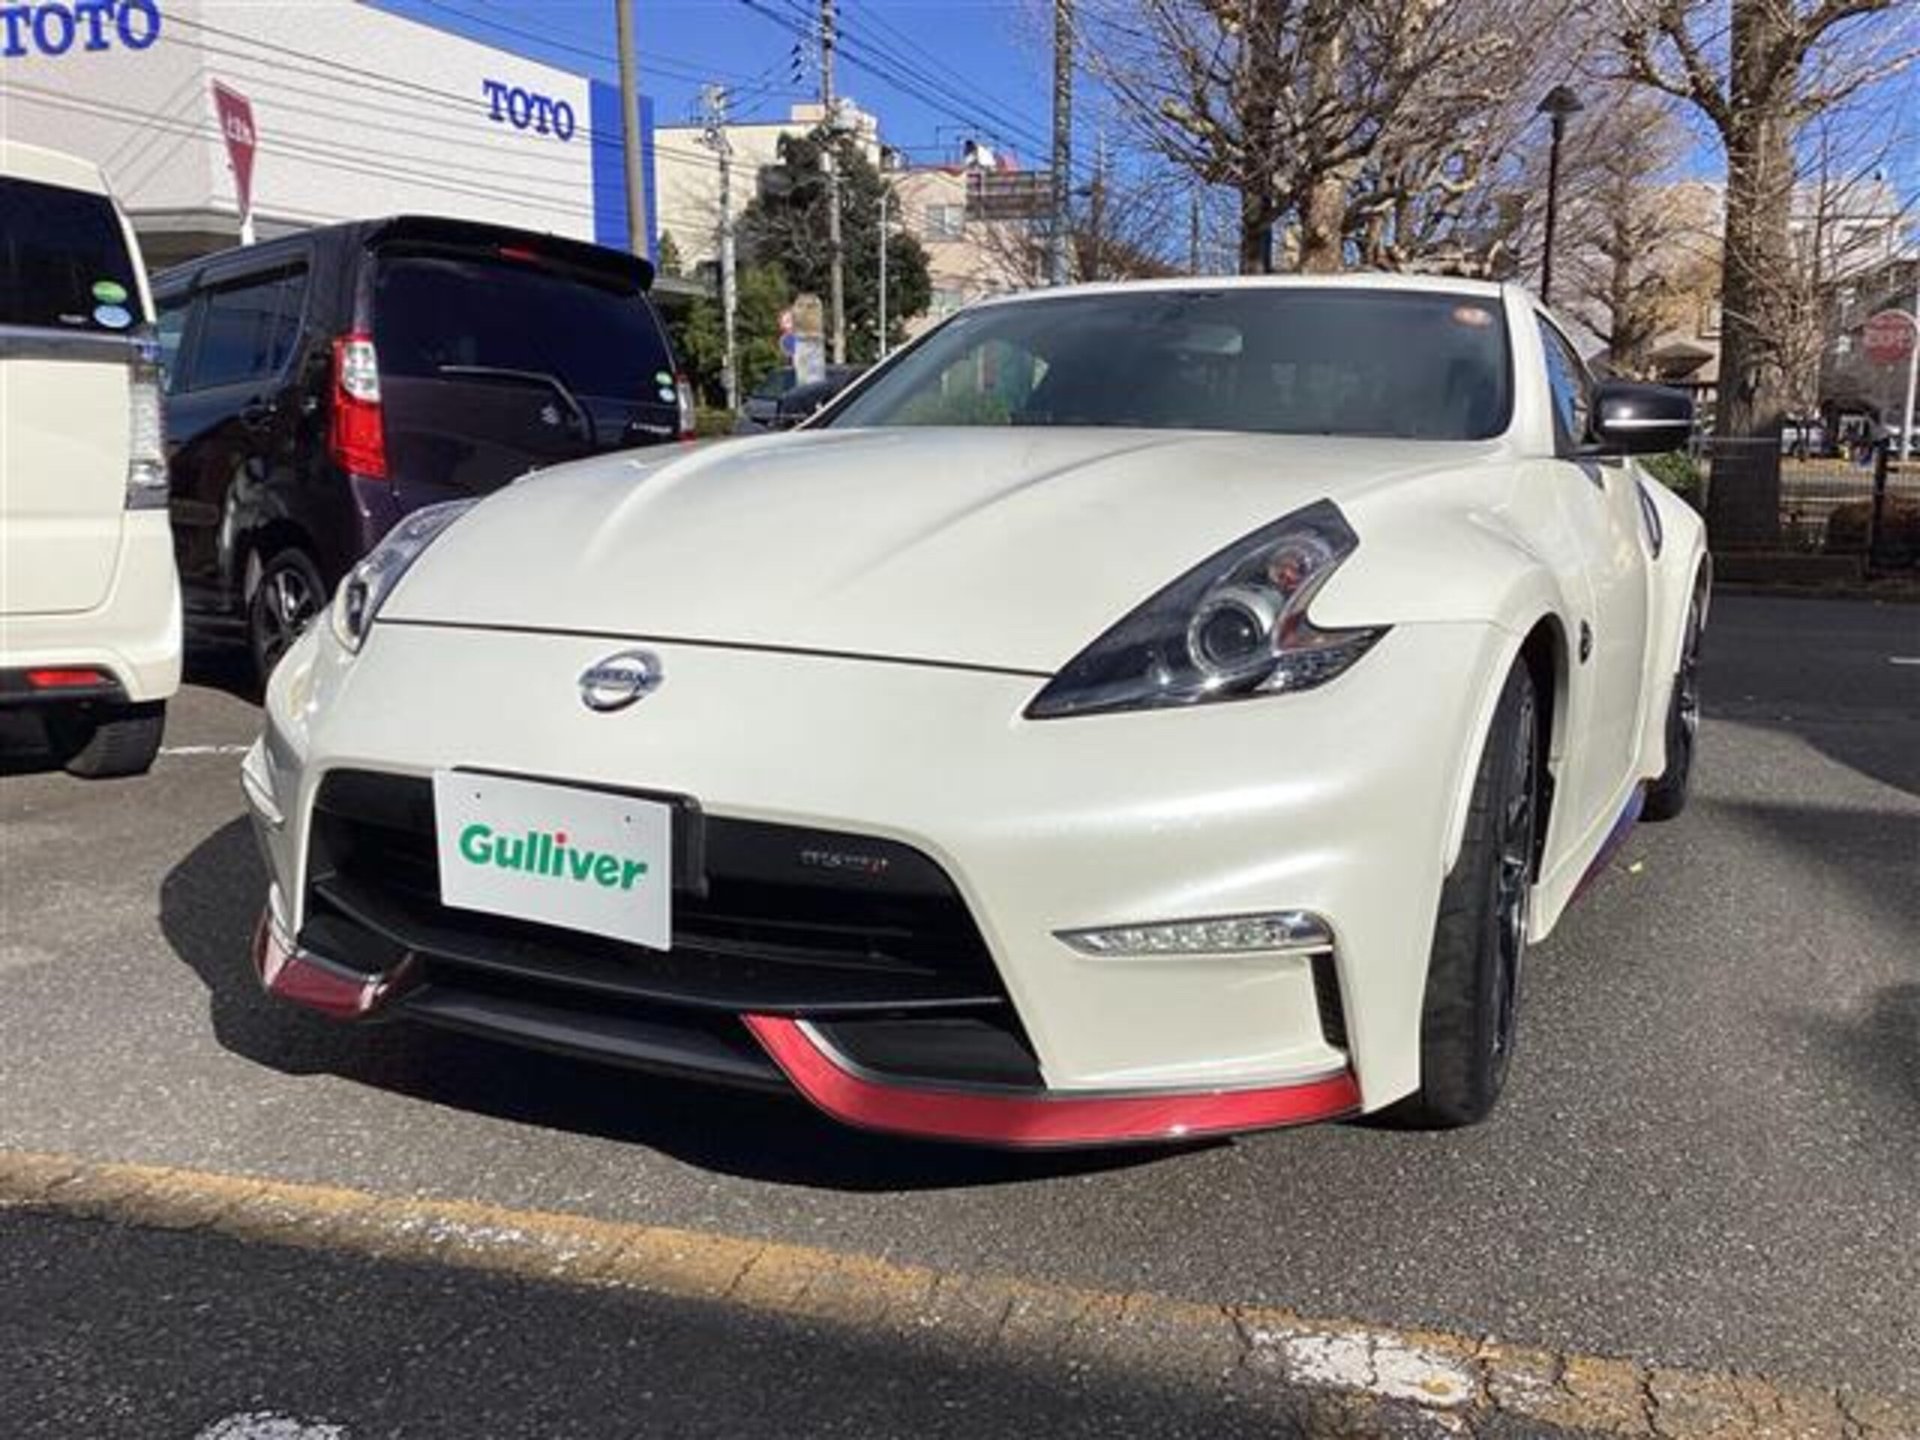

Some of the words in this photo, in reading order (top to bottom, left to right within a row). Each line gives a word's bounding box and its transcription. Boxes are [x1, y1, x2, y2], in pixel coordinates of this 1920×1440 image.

[0, 0, 161, 57] TOTO
[482, 79, 574, 142] TOTO
[459, 824, 648, 890] Gulliver
